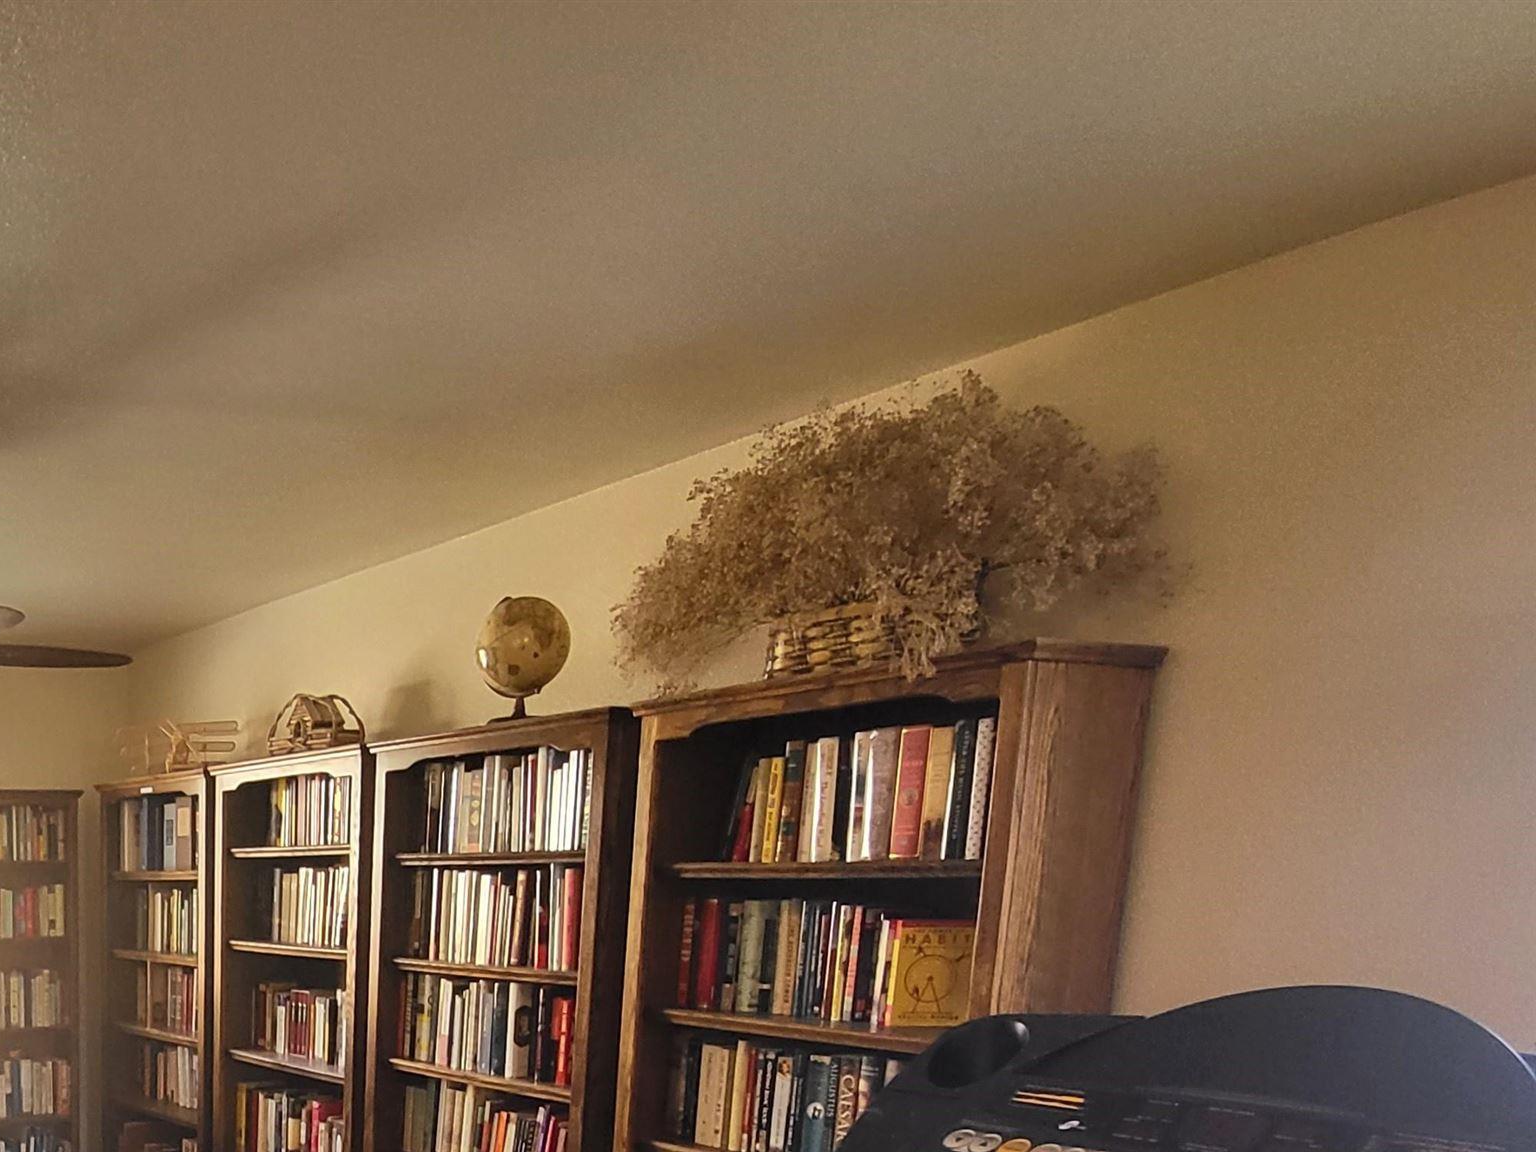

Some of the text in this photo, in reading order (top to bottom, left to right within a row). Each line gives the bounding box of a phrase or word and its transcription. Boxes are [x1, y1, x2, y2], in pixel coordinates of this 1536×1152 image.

[905, 933, 971, 945] HABIT
[826, 1064, 839, 1117] AUGUSTUS
[835, 1074, 856, 1142] CAESAR
